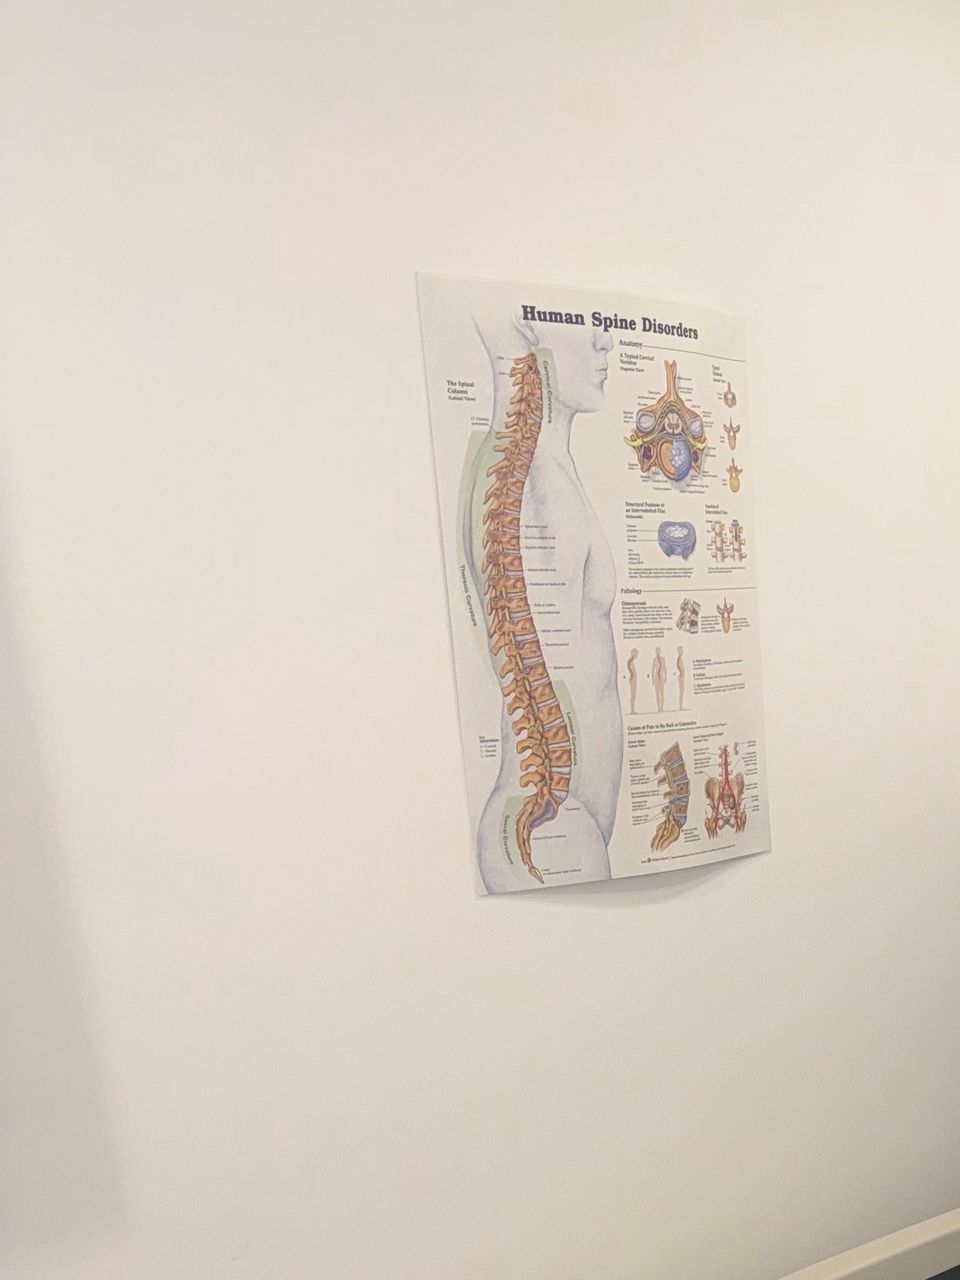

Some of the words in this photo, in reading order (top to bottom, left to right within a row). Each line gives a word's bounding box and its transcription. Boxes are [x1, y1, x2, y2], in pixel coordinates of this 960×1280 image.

[521, 305, 585, 325] Human
[591, 311, 636, 332] Spine
[641, 317, 698, 339] Disorders
[618, 339, 643, 350] Anatomy
[459, 565, 469, 595] Thoracic
[465, 595, 477, 627] Curvature
